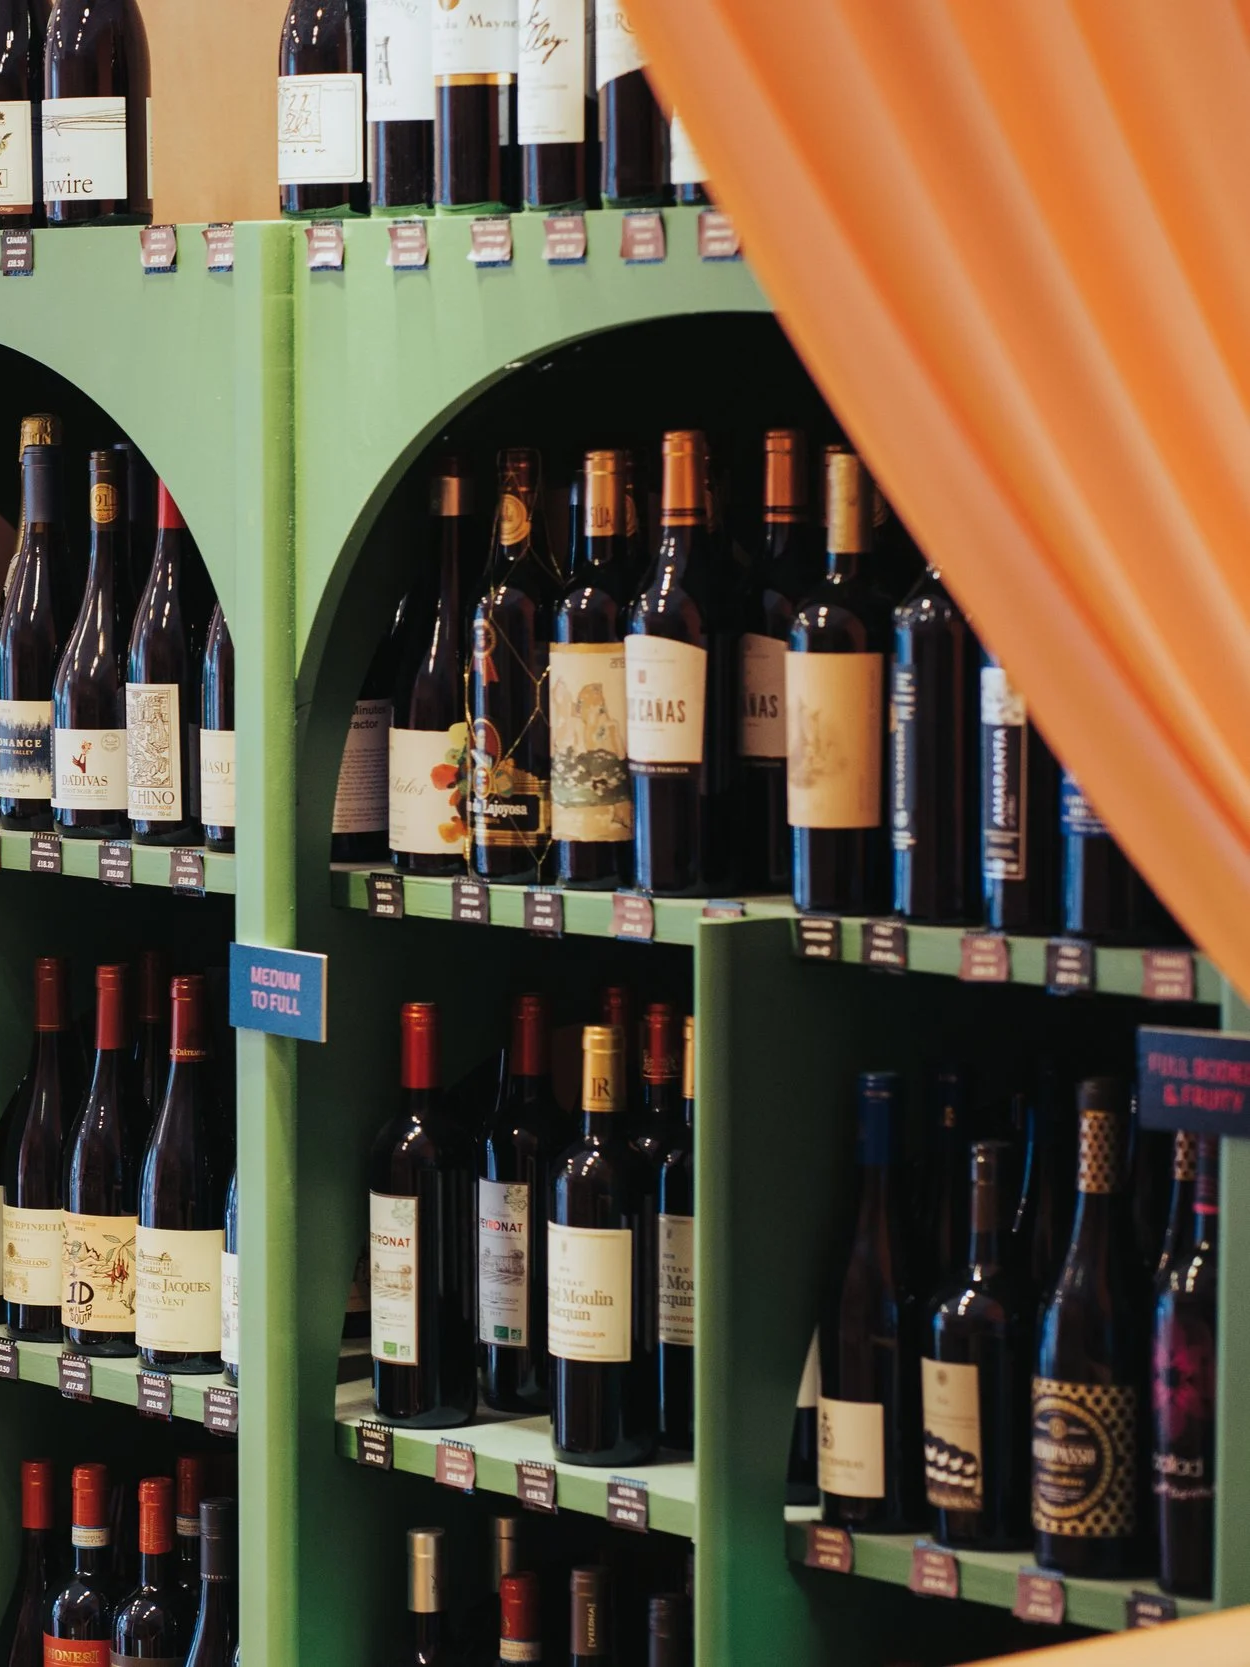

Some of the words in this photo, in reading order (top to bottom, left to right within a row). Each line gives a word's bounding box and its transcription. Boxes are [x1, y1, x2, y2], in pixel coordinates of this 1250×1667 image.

[6, 236, 27, 244] CANADA
[640, 698, 686, 723] CAÑAS
[483, 799, 528, 818] Lajoyosa
[109, 848, 120, 856] USA
[181, 855, 193, 864] USA
[251, 965, 302, 992] MEDIUM
[251, 990, 268, 1010] TO
[269, 993, 302, 1016] FULL
[1148, 1052, 1189, 1079] FULL
[563, 1289, 614, 1307] Moulin
[68, 1304, 93, 1314] WILD
[70, 1311, 93, 1325] SOUTH
[143, 1376, 165, 1388] FRANCE
[210, 1394, 231, 1405] FRANCE
[362, 1429, 385, 1442] FRANCE
[445, 1448, 468, 1460] FRANCE
[522, 1467, 547, 1479] FRANCE
